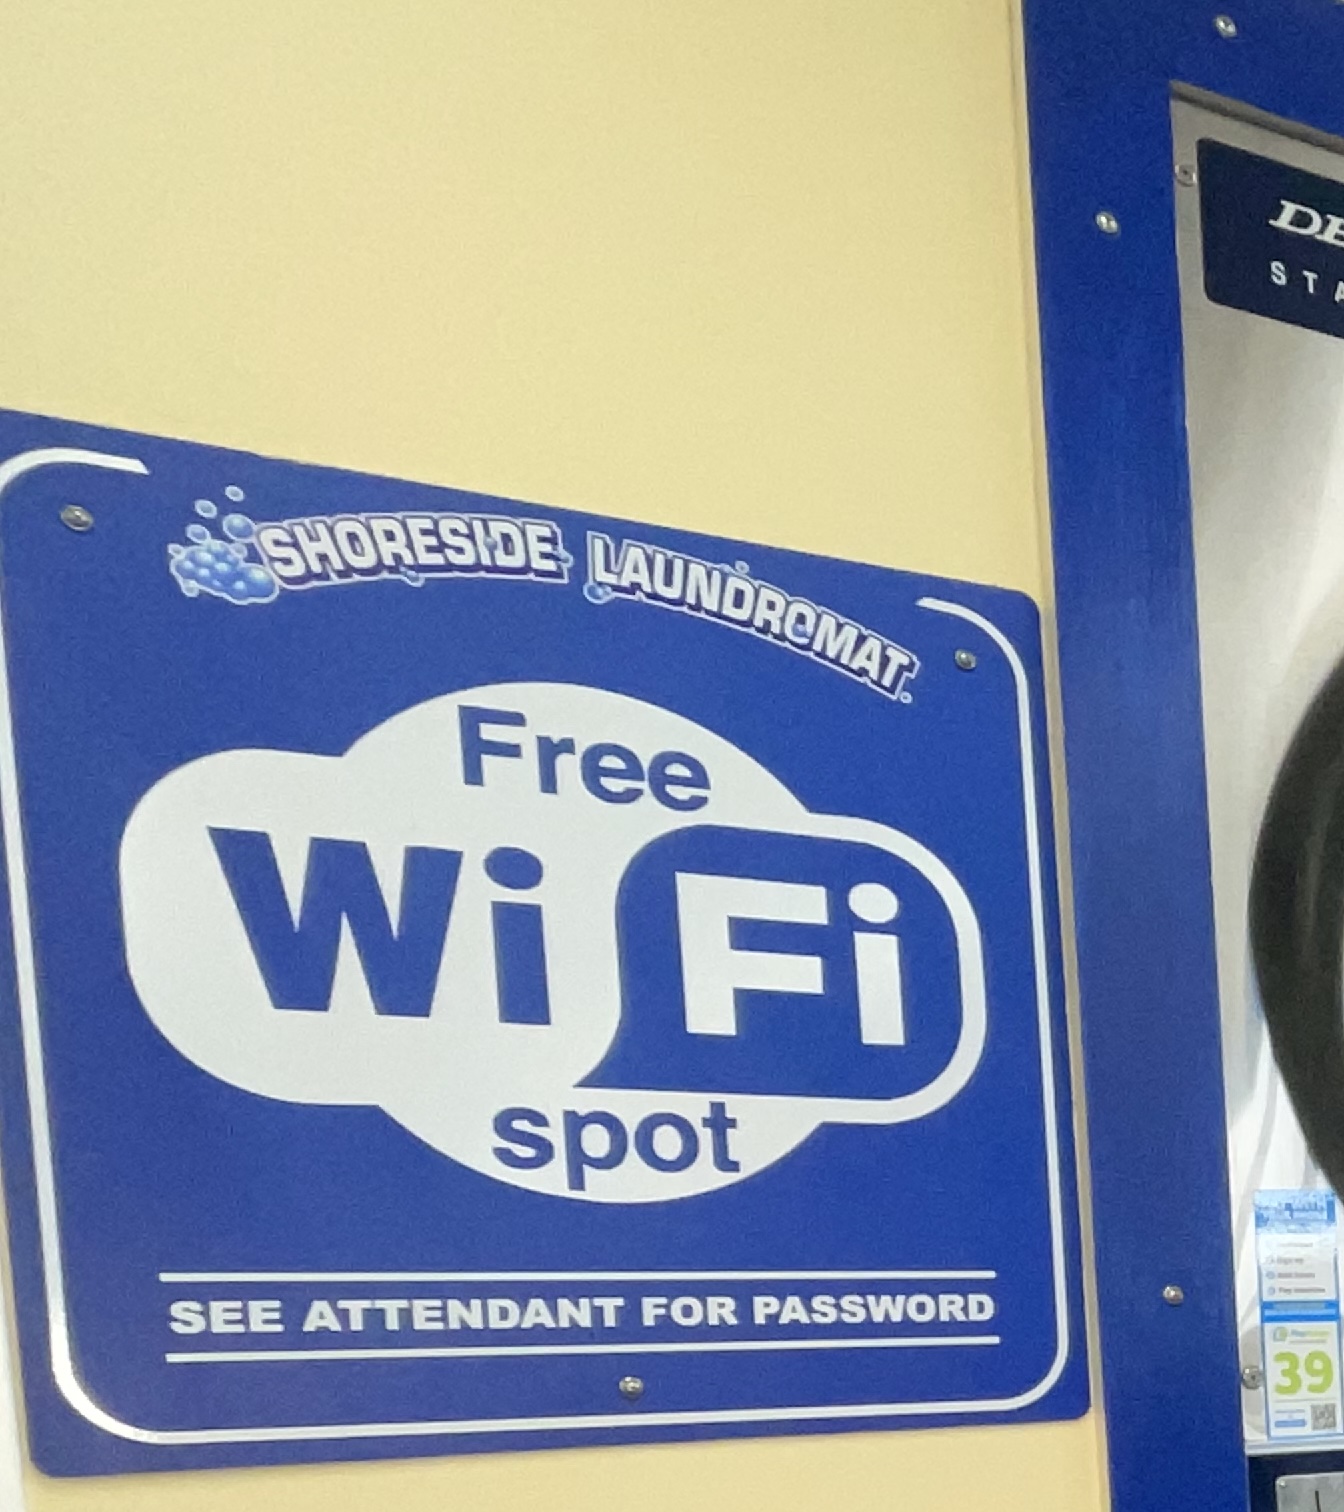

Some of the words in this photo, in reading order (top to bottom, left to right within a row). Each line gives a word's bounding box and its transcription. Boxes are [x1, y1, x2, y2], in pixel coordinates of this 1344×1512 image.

[258, 514, 565, 585] SHORESIDE
[590, 532, 918, 695] LAUNDROMAT
[457, 704, 712, 812] Free
[490, 1099, 741, 1191] spot
[168, 1298, 285, 1335] SEE
[302, 1295, 624, 1333] ATTENDANT
[640, 1294, 740, 1328] FOR
[753, 1291, 996, 1326] PASSWORD
[1273, 1350, 1335, 1396] 39
